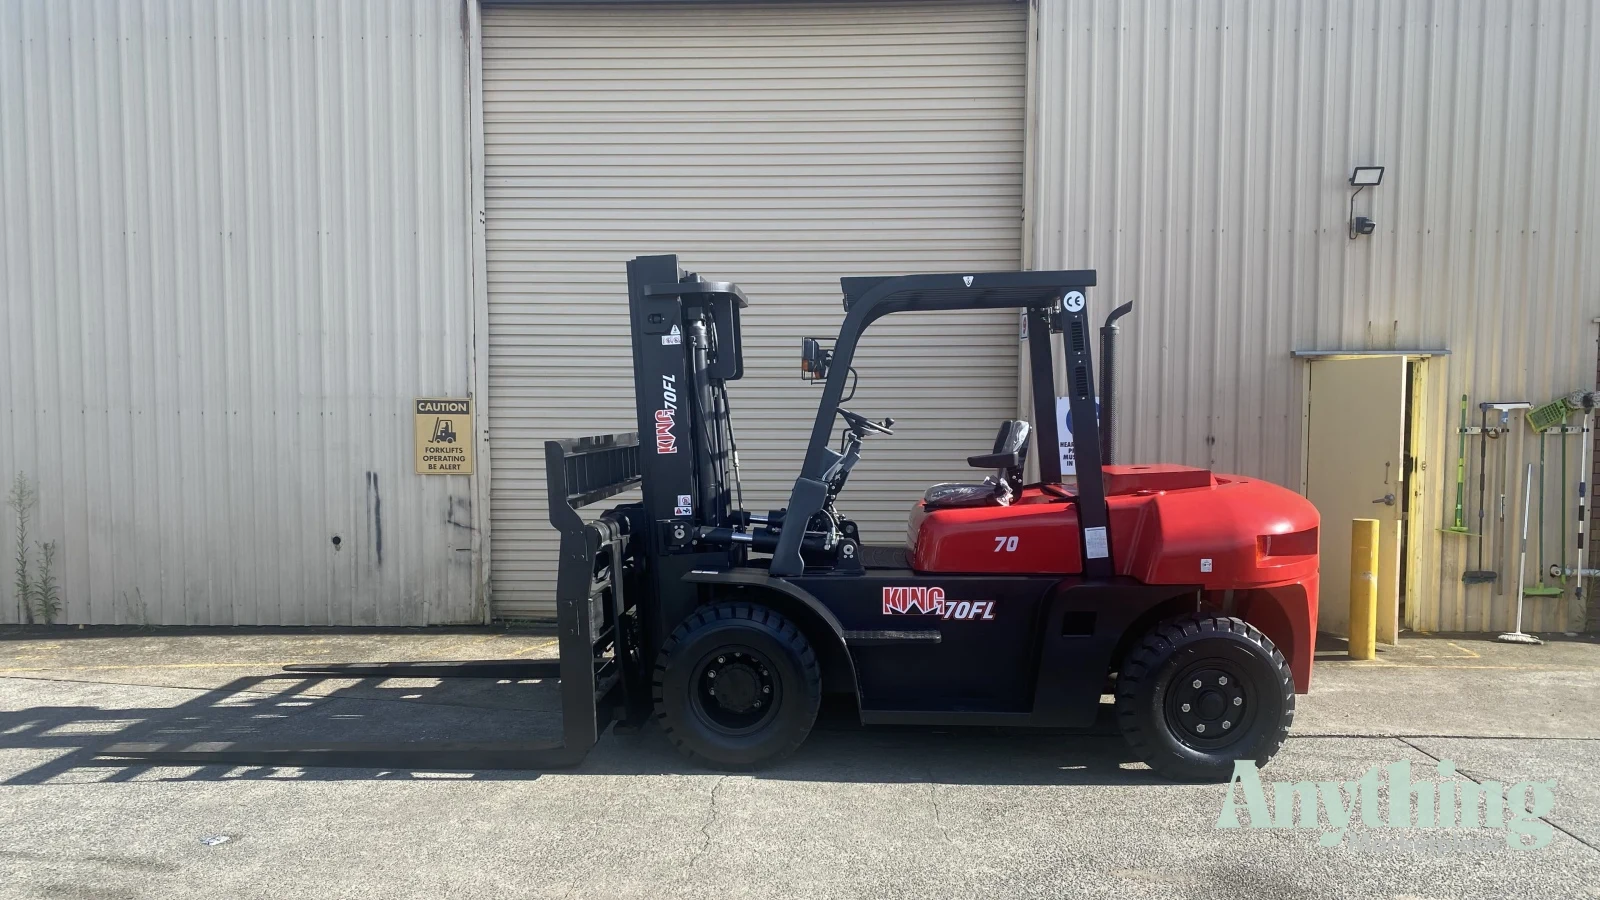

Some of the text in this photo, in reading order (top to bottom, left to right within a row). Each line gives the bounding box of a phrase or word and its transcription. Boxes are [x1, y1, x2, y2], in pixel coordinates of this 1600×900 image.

[418, 402, 467, 412] CAUTION
[655, 374, 678, 454] KING 70FL
[424, 446, 463, 454] FORKLIFTS
[993, 535, 1019, 553] 70
[882, 586, 996, 620] KING 70FL
